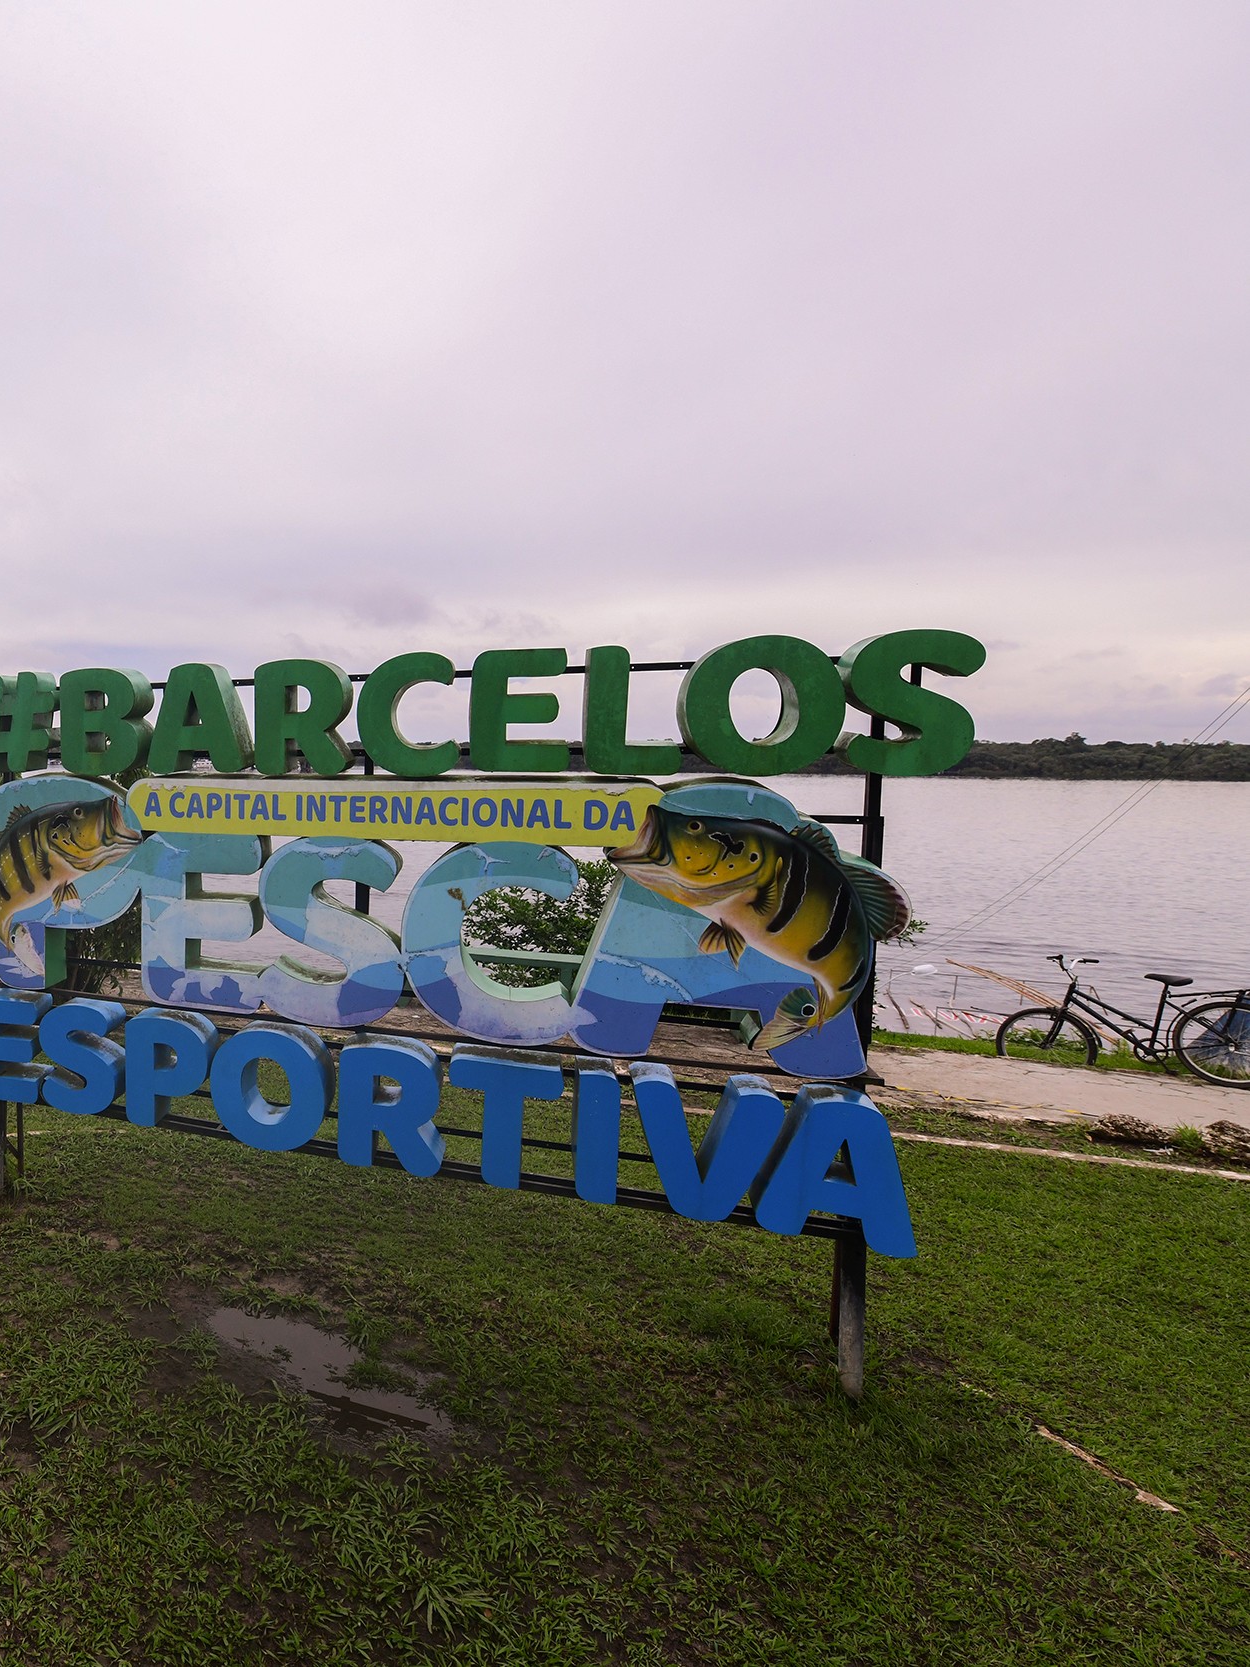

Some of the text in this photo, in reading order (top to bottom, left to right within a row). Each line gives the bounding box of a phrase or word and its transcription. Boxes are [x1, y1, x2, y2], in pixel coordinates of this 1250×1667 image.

[143, 791, 636, 831] A CAPITAL INTERNACIONAL DA
